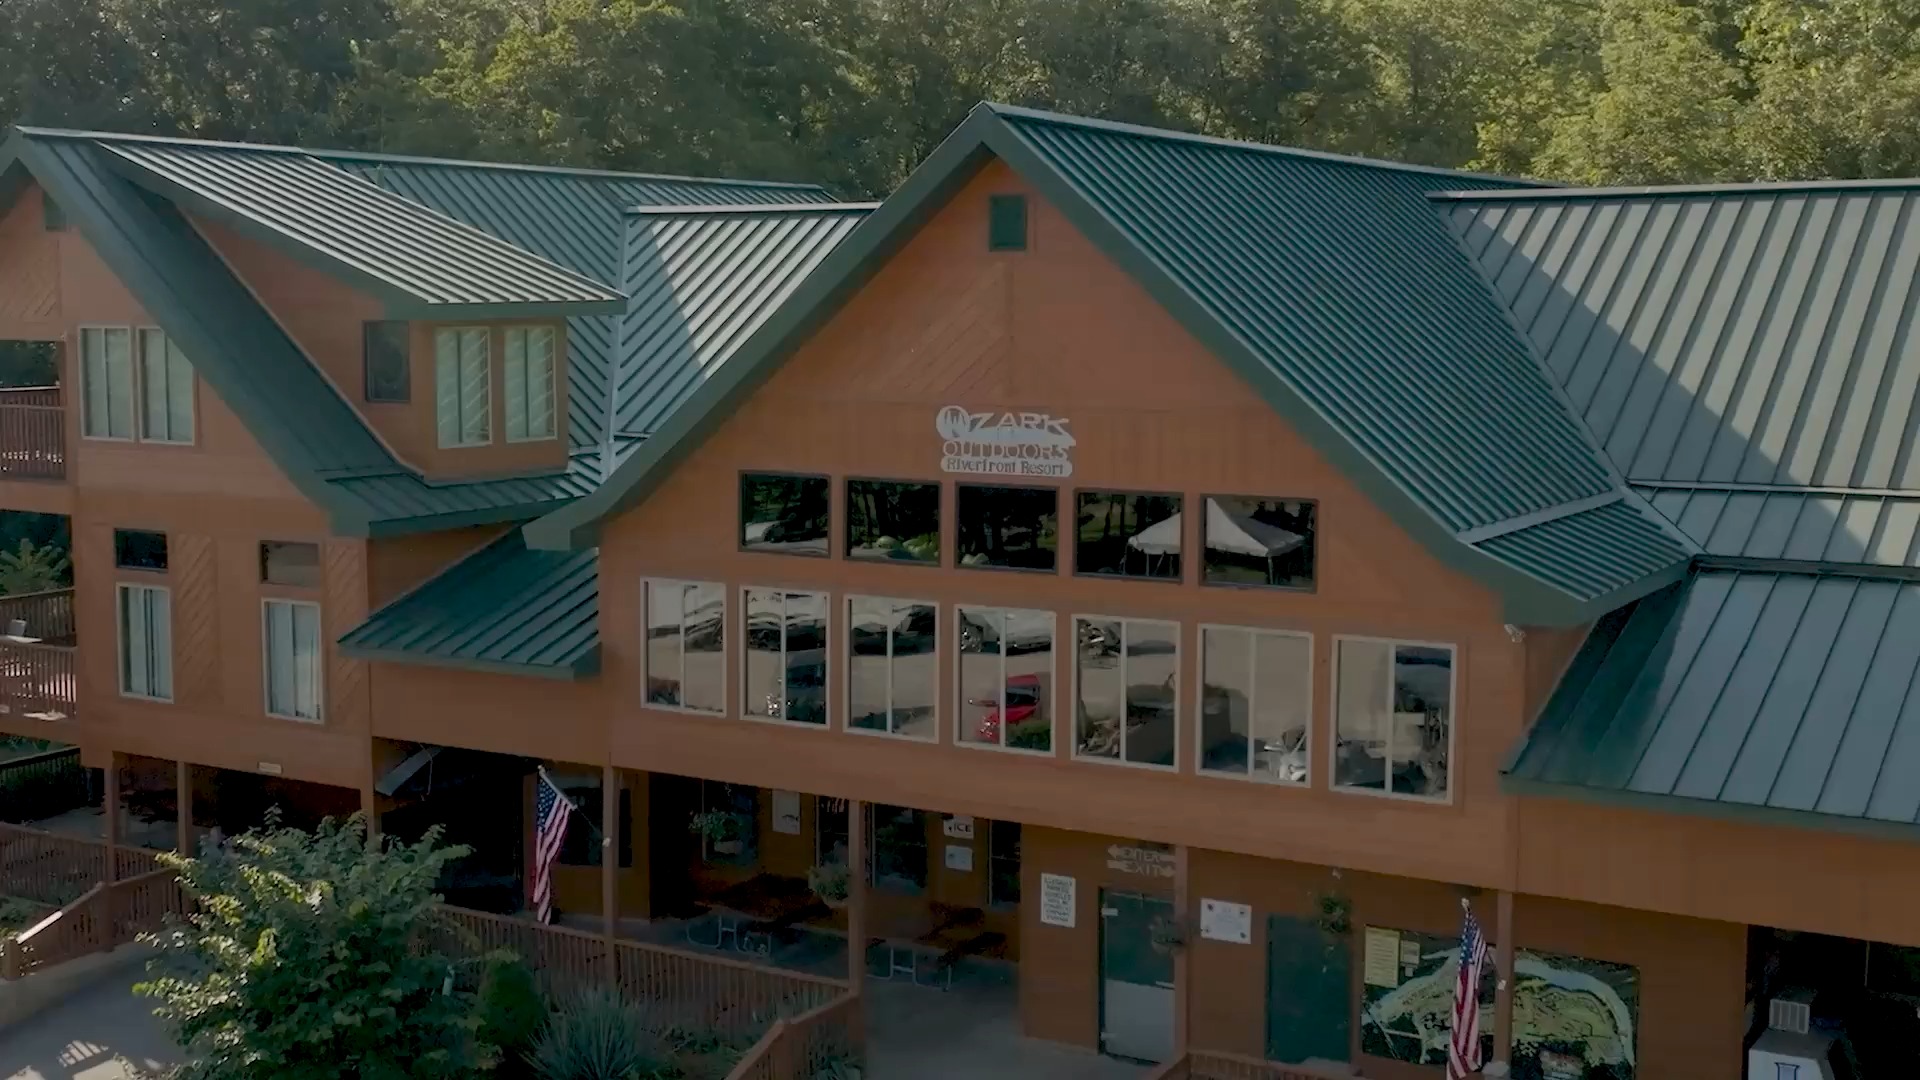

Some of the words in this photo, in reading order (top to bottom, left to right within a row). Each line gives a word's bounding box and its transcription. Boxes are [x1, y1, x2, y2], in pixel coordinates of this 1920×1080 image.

[936, 405, 1076, 446] OZARK
[943, 440, 1068, 459] OUTDOORS
[947, 457, 1016, 473] Riverfront
[1021, 460, 1064, 475] Resort
[953, 823, 972, 833] ICE
